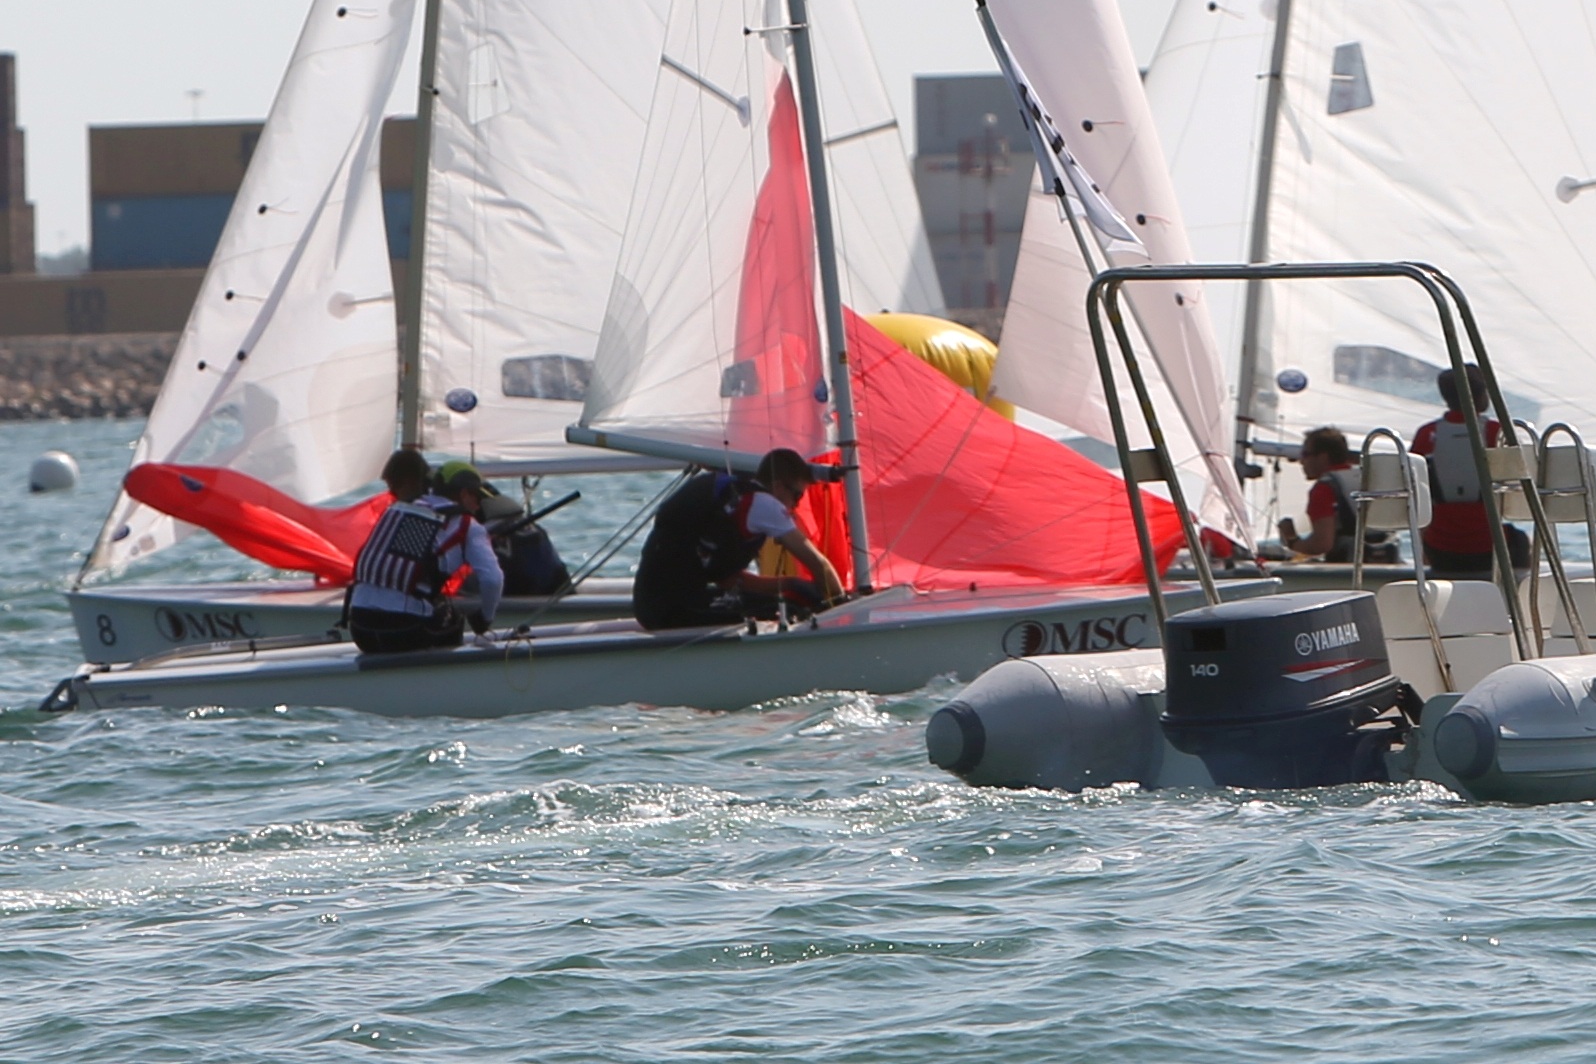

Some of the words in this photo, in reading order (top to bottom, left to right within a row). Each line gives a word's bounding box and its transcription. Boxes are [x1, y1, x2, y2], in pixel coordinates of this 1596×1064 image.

[97, 614, 116, 646] 8
[184, 612, 261, 639] MSC
[1050, 613, 1147, 653] MSC
[1311, 622, 1360, 651] YAMAHA
[1190, 663, 1219, 676] 140
